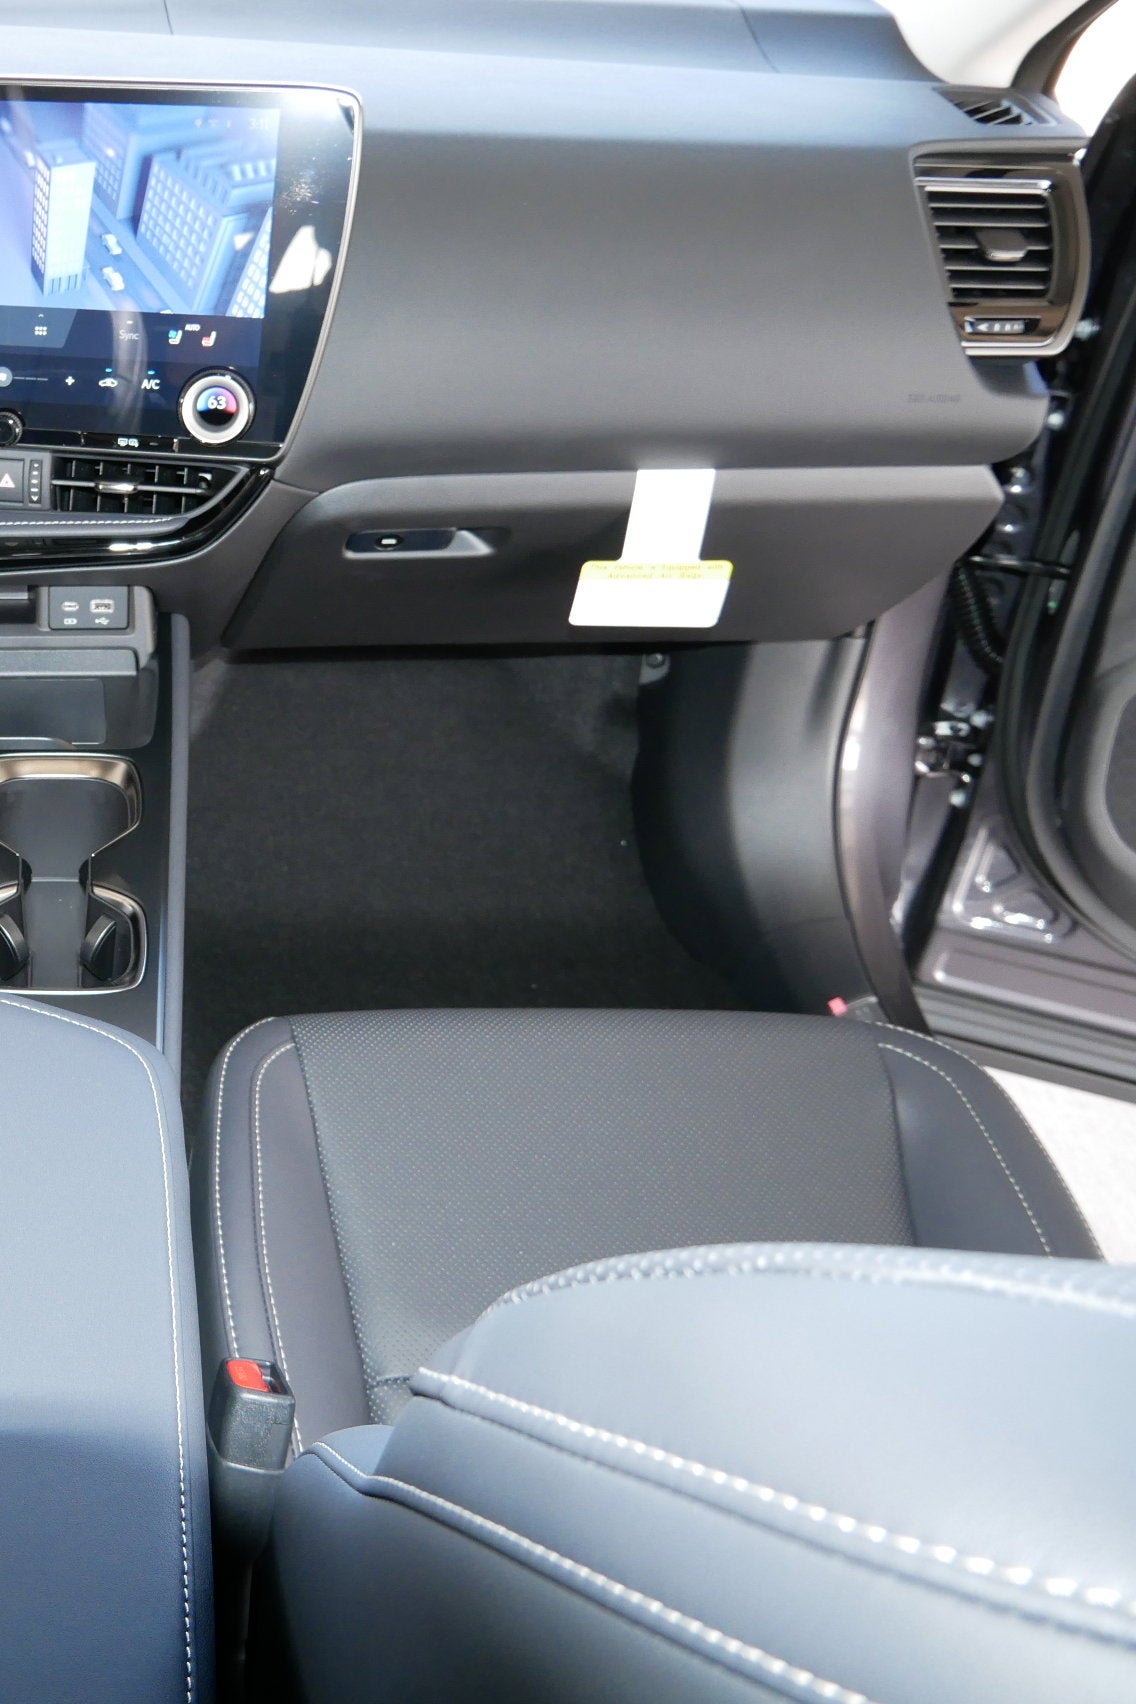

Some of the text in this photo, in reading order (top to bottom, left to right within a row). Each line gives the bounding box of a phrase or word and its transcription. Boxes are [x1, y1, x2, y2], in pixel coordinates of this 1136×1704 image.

[185, 323, 201, 331] AUTO
[119, 329, 140, 340] Sync
[141, 378, 161, 390] A/C
[207, 395, 228, 410] 63
